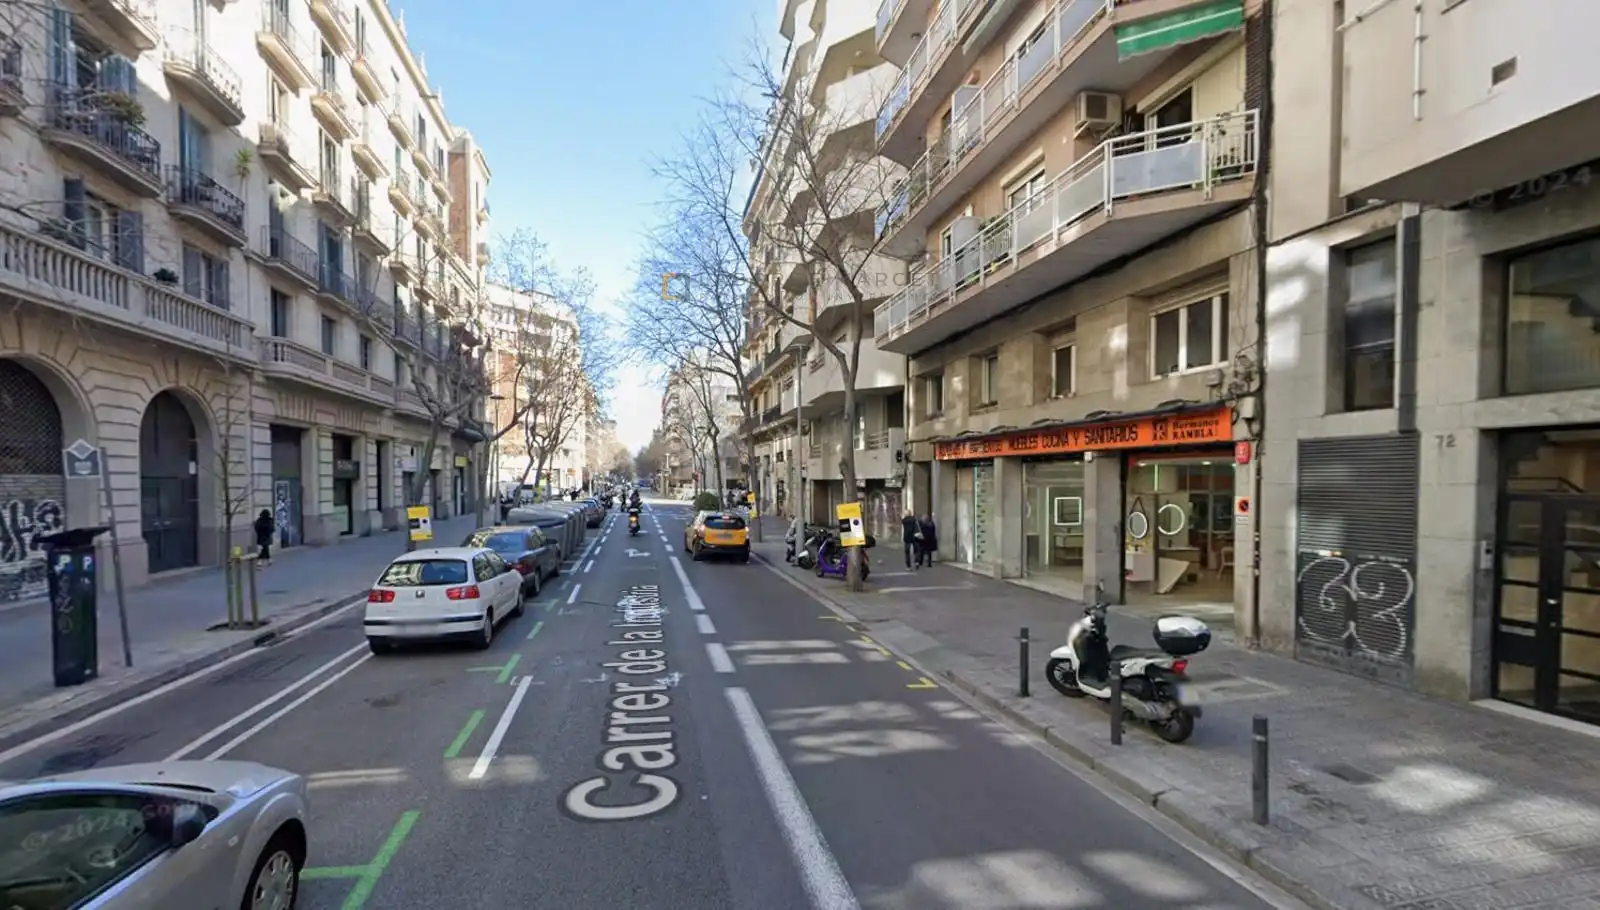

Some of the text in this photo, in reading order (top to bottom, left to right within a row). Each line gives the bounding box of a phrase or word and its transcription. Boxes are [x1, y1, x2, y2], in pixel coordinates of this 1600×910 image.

[1072, 431, 1080, 447] Y
[1084, 424, 1138, 445] SANITARIOS
[1434, 434, 1456, 450] 72
